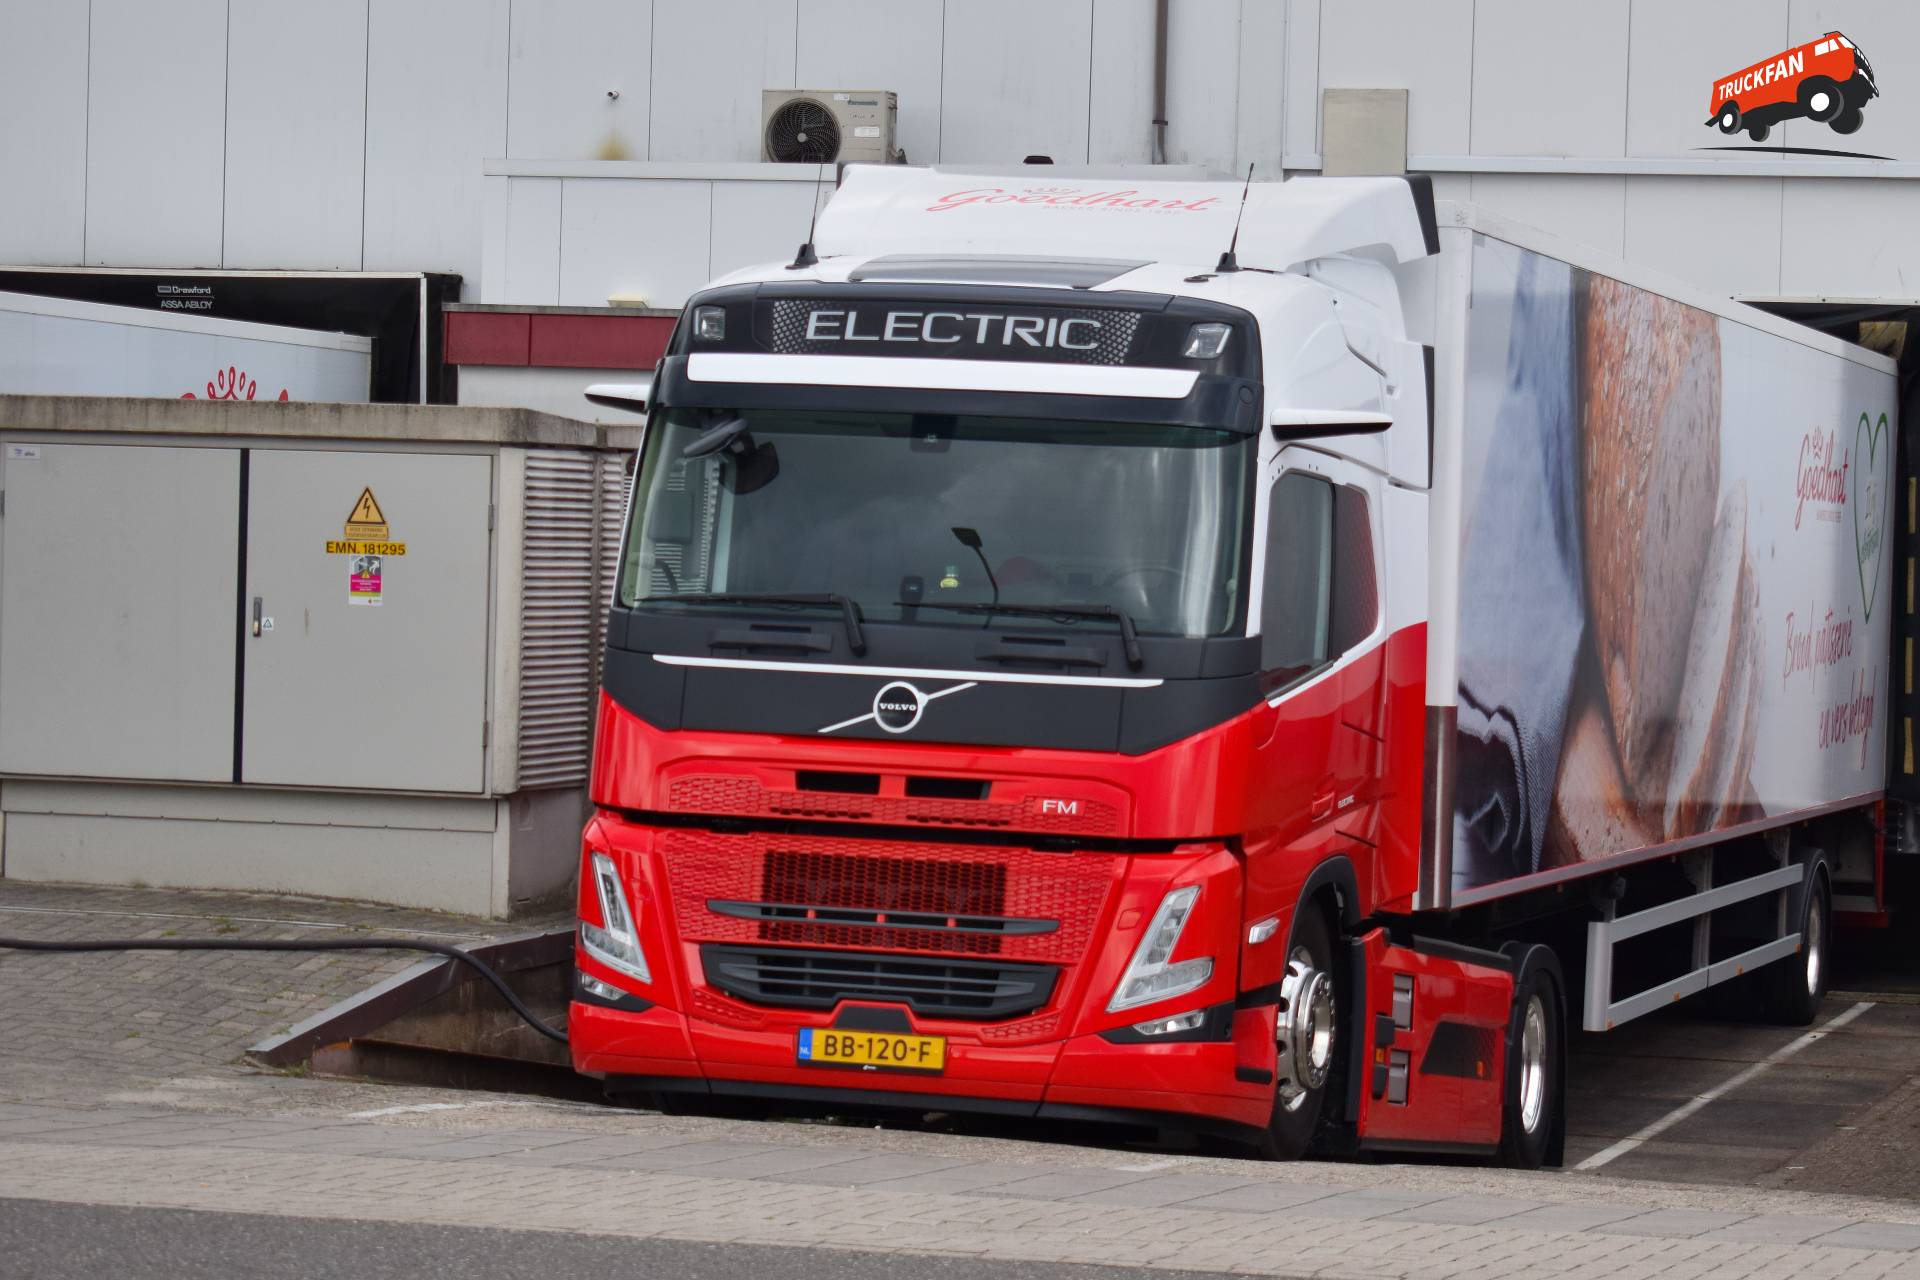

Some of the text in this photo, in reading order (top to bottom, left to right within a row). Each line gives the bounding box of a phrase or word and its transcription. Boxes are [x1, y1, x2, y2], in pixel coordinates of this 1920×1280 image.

[926, 188, 1220, 212] Goedhart
[172, 286, 211, 294] Crawford
[160, 300, 213, 309] ASSA ABLOY
[806, 311, 1101, 350] ELECTRIC
[880, 703, 917, 711] VOLVO
[1043, 800, 1077, 815] FM
[800, 1034, 932, 1063] NL BB-120-F
